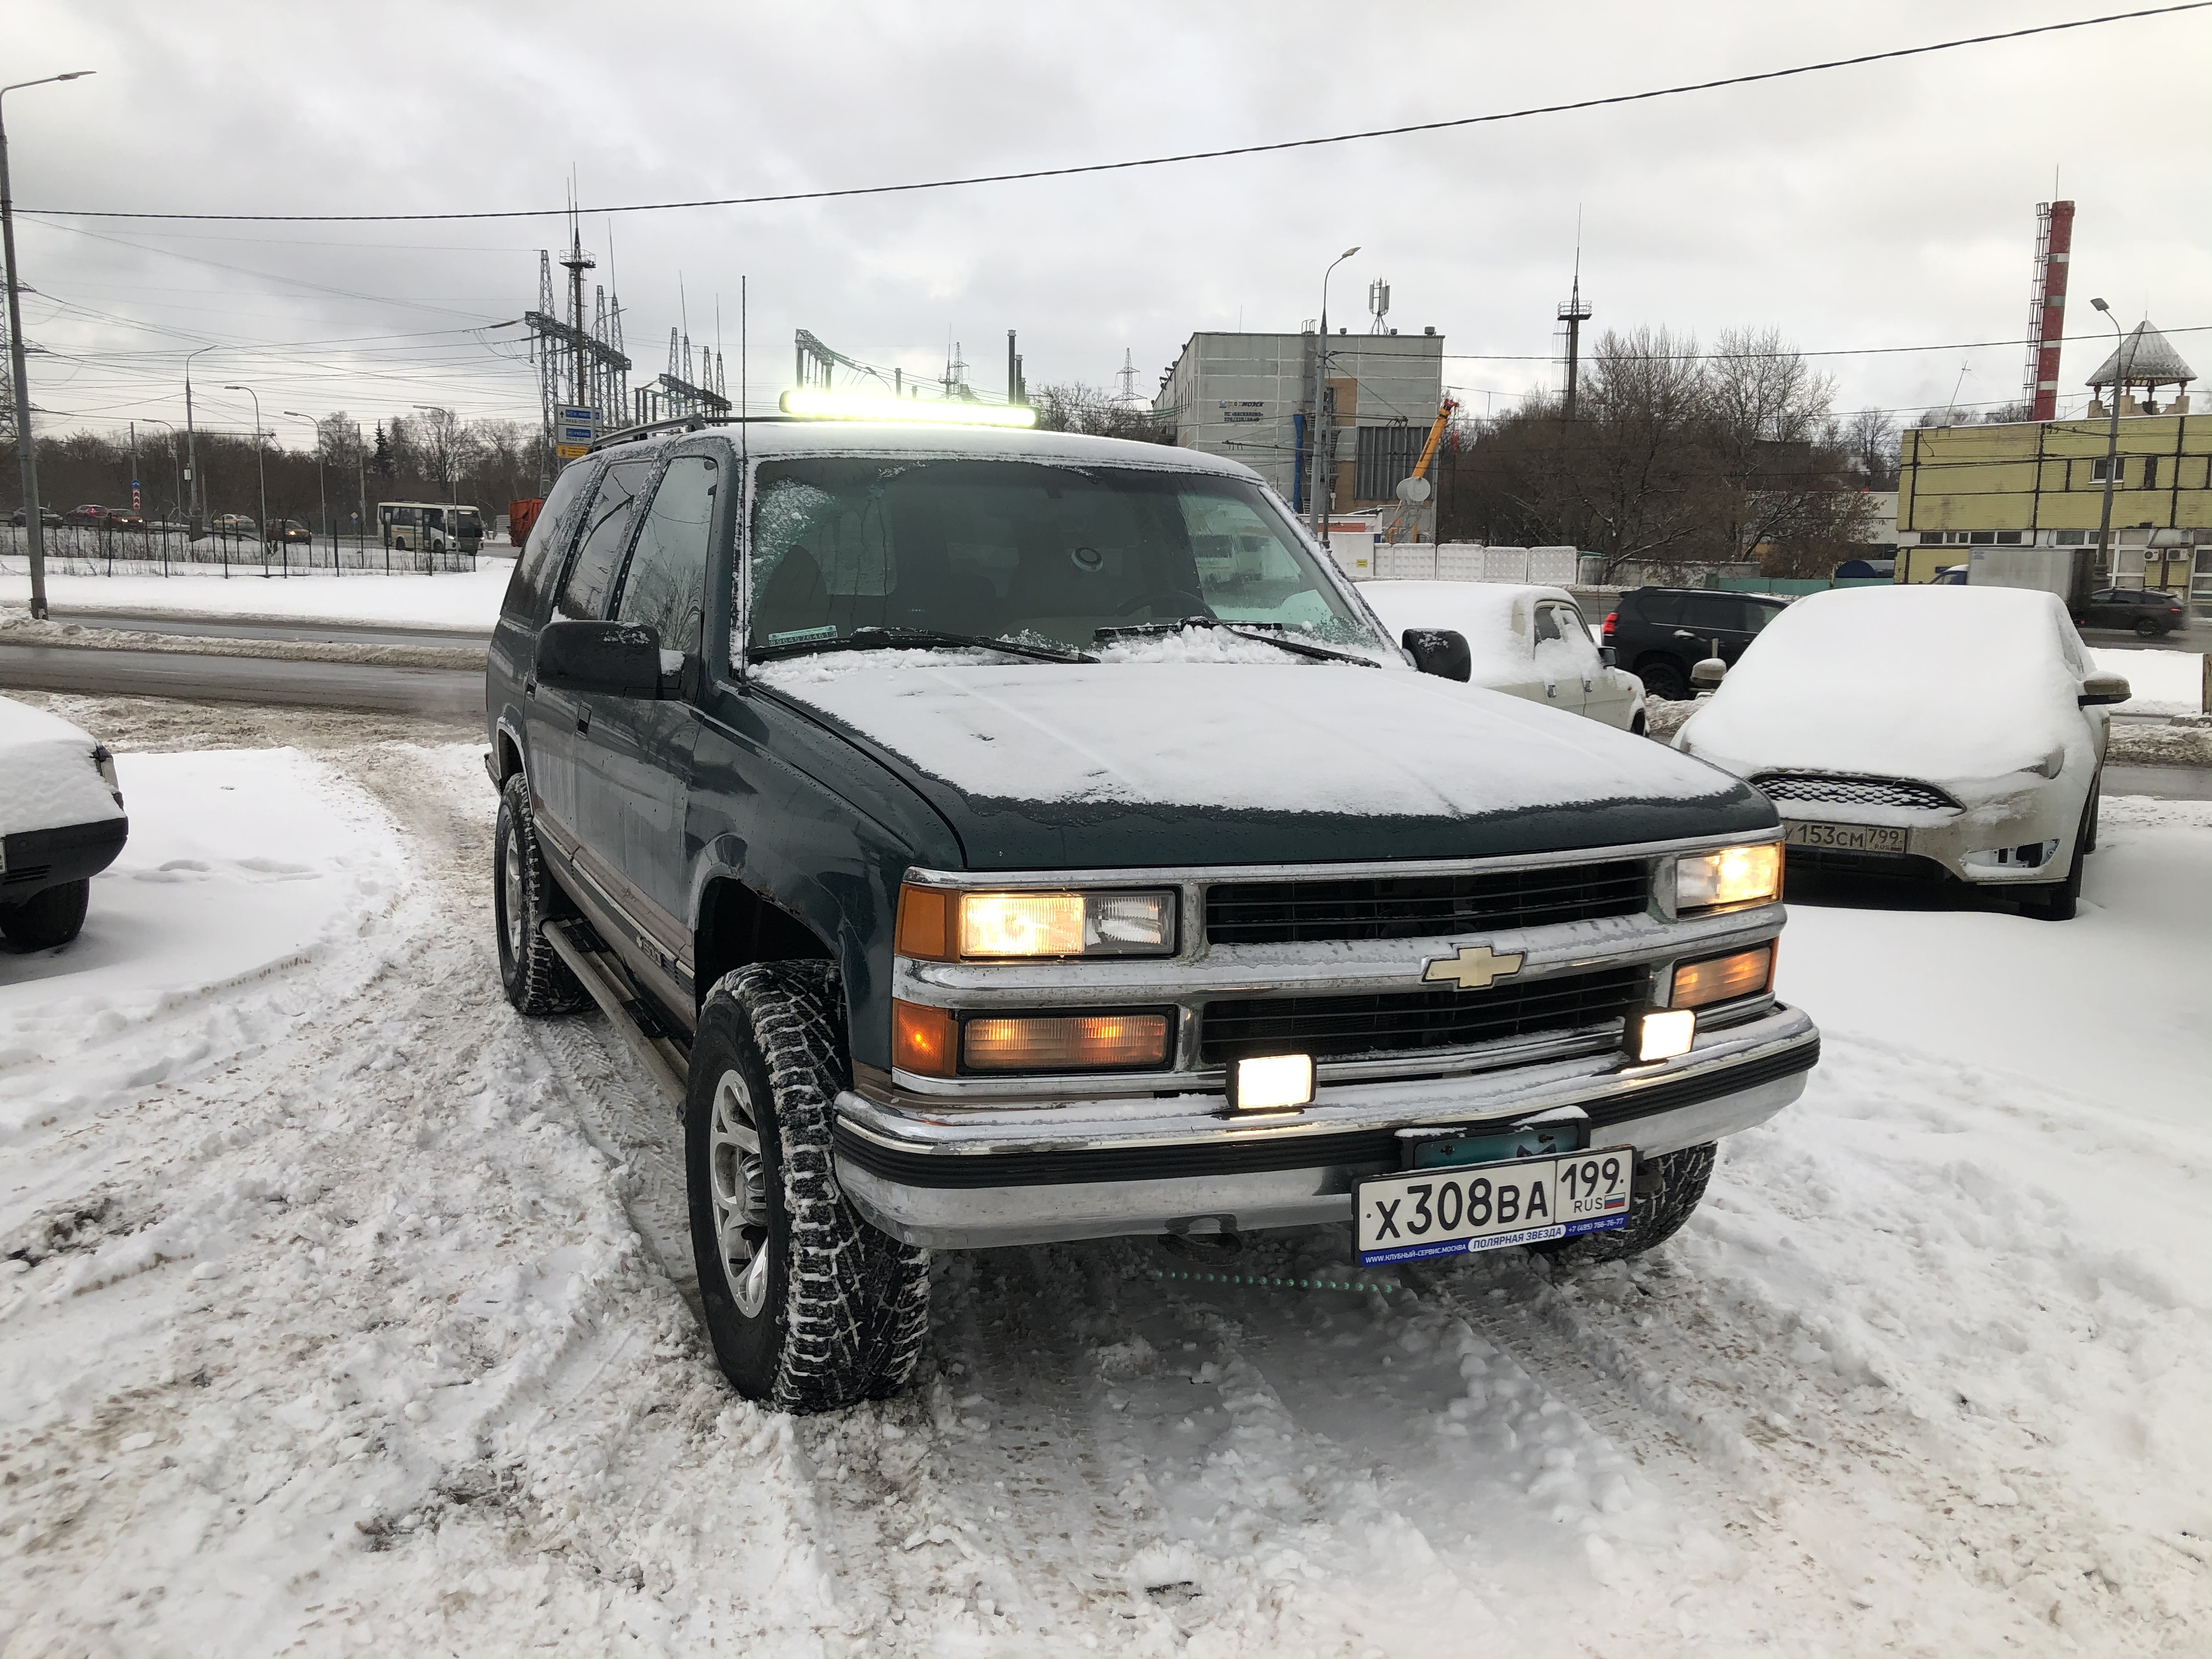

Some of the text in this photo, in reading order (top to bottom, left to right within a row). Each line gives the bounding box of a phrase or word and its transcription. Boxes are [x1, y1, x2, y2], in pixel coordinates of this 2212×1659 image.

[1868, 828, 1899, 844] 799
[1560, 1158, 1620, 1200] 199
[1573, 1197, 1603, 1214] RUS
[1577, 1223, 1593, 1232] (495)
[1473, 1227, 1562, 1250] ПОЛЯРНАЯ ЗВЕЗДА
[1365, 1244, 1466, 1263] WWW.КЛУБНЫЙ-СЕРВИС.МОСКВА
